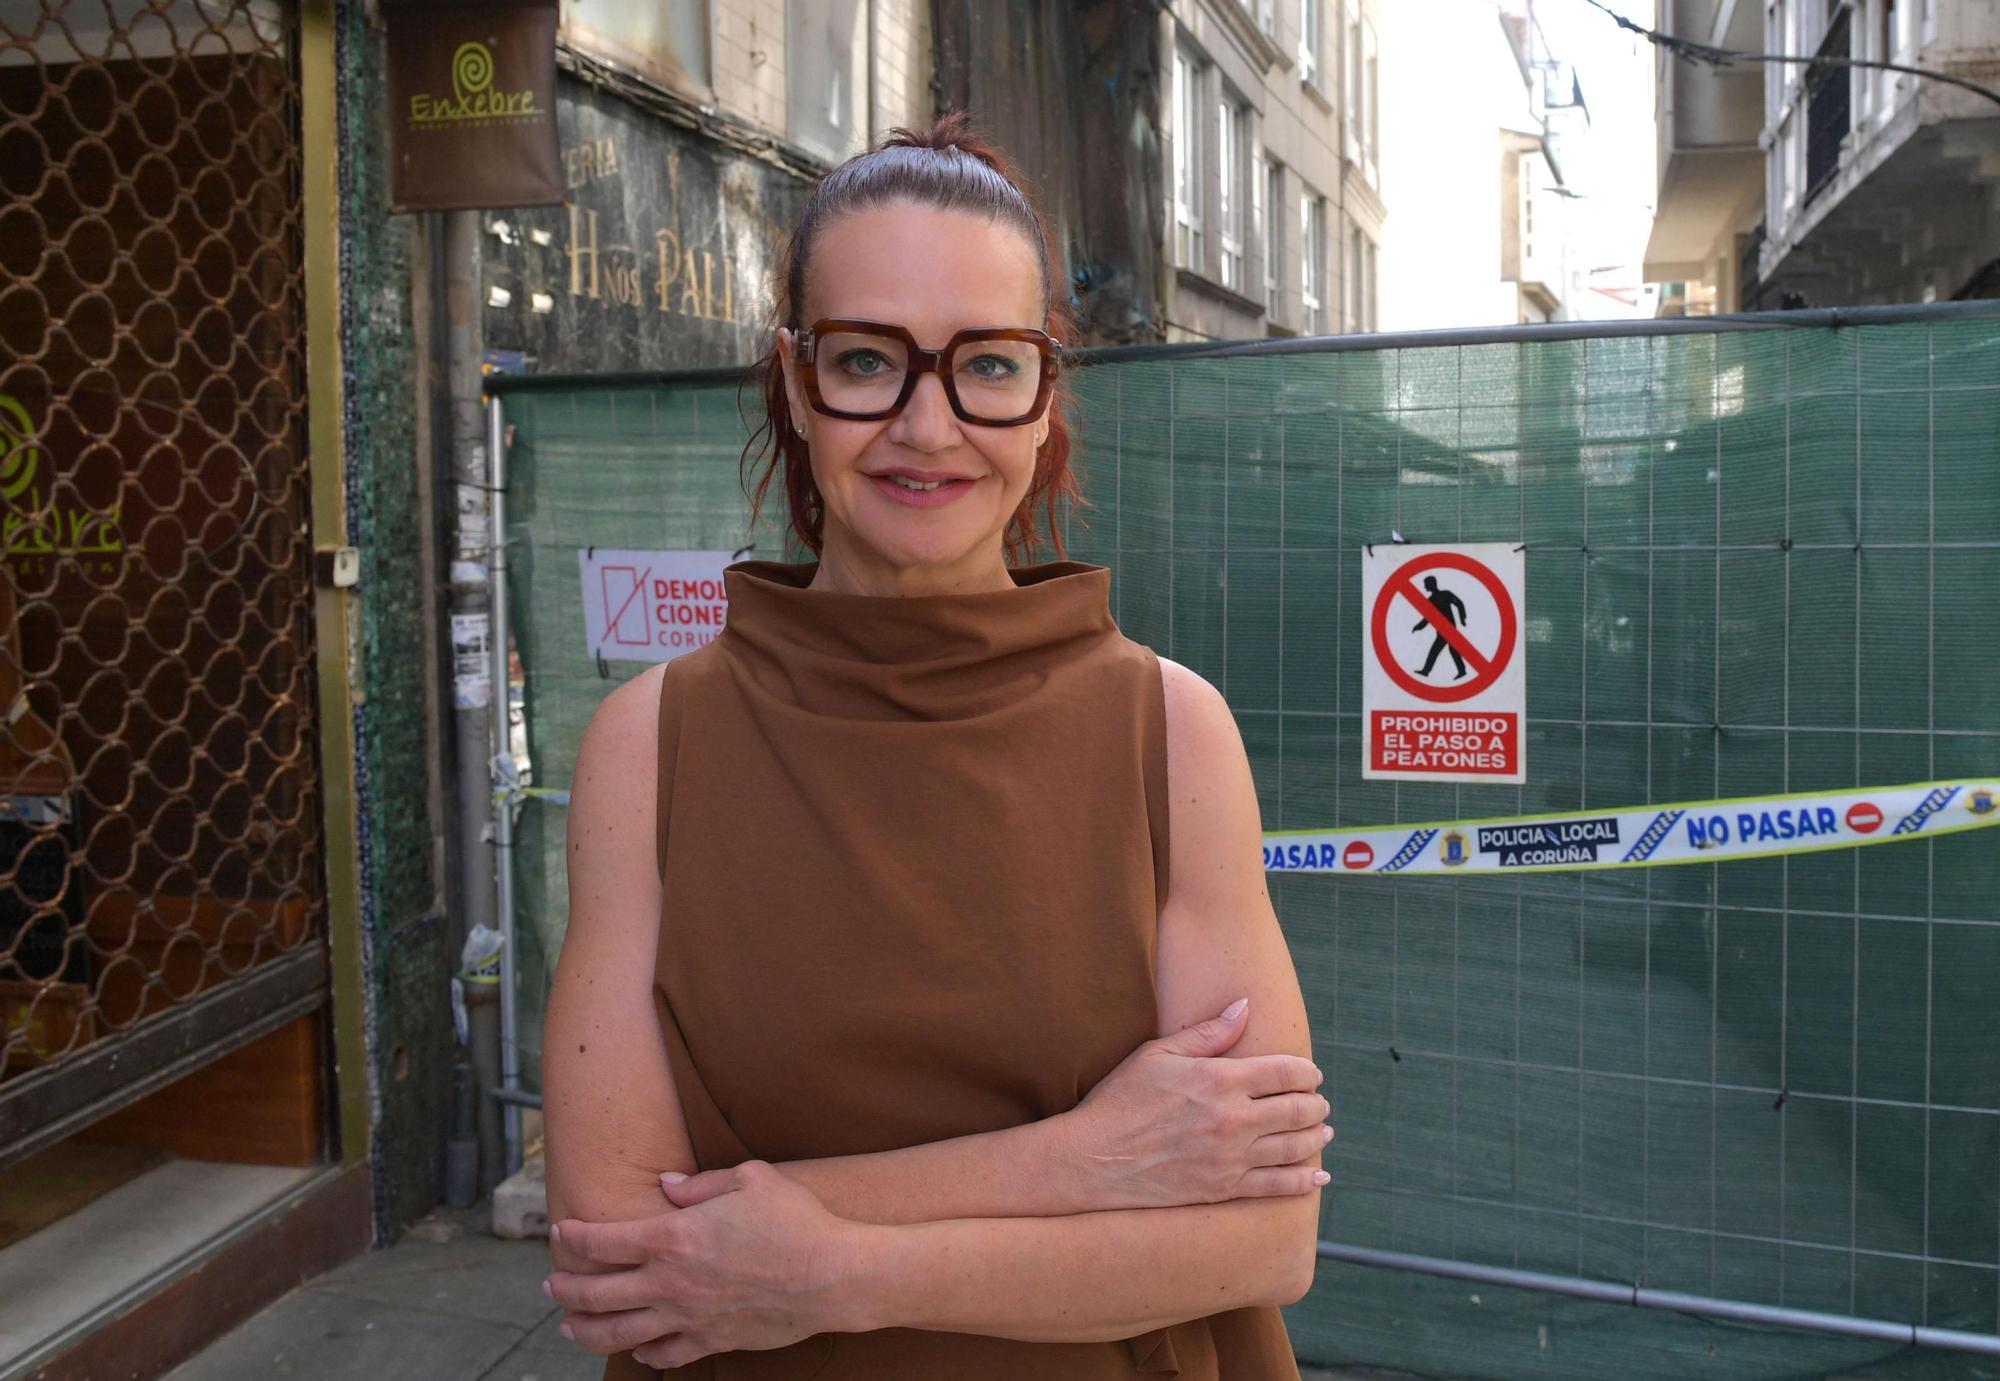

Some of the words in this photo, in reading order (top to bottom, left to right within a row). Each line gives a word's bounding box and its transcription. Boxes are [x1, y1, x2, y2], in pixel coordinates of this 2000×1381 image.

[410, 86, 535, 119] Enxebre
[1381, 716, 1508, 734] PROHIBIDO
[1384, 733, 1412, 749] EL
[1419, 734, 1482, 751] PASO
[1489, 736, 1505, 751] A
[1382, 751, 1506, 769] PEATONES
[1480, 827, 1546, 847] POLICIA
[1560, 822, 1616, 842] LOCAL
[1687, 815, 1729, 848] NO
[1738, 806, 1837, 843] PASAR
[1505, 852, 1518, 866] A
[1521, 844, 1593, 864] CORUÑA
